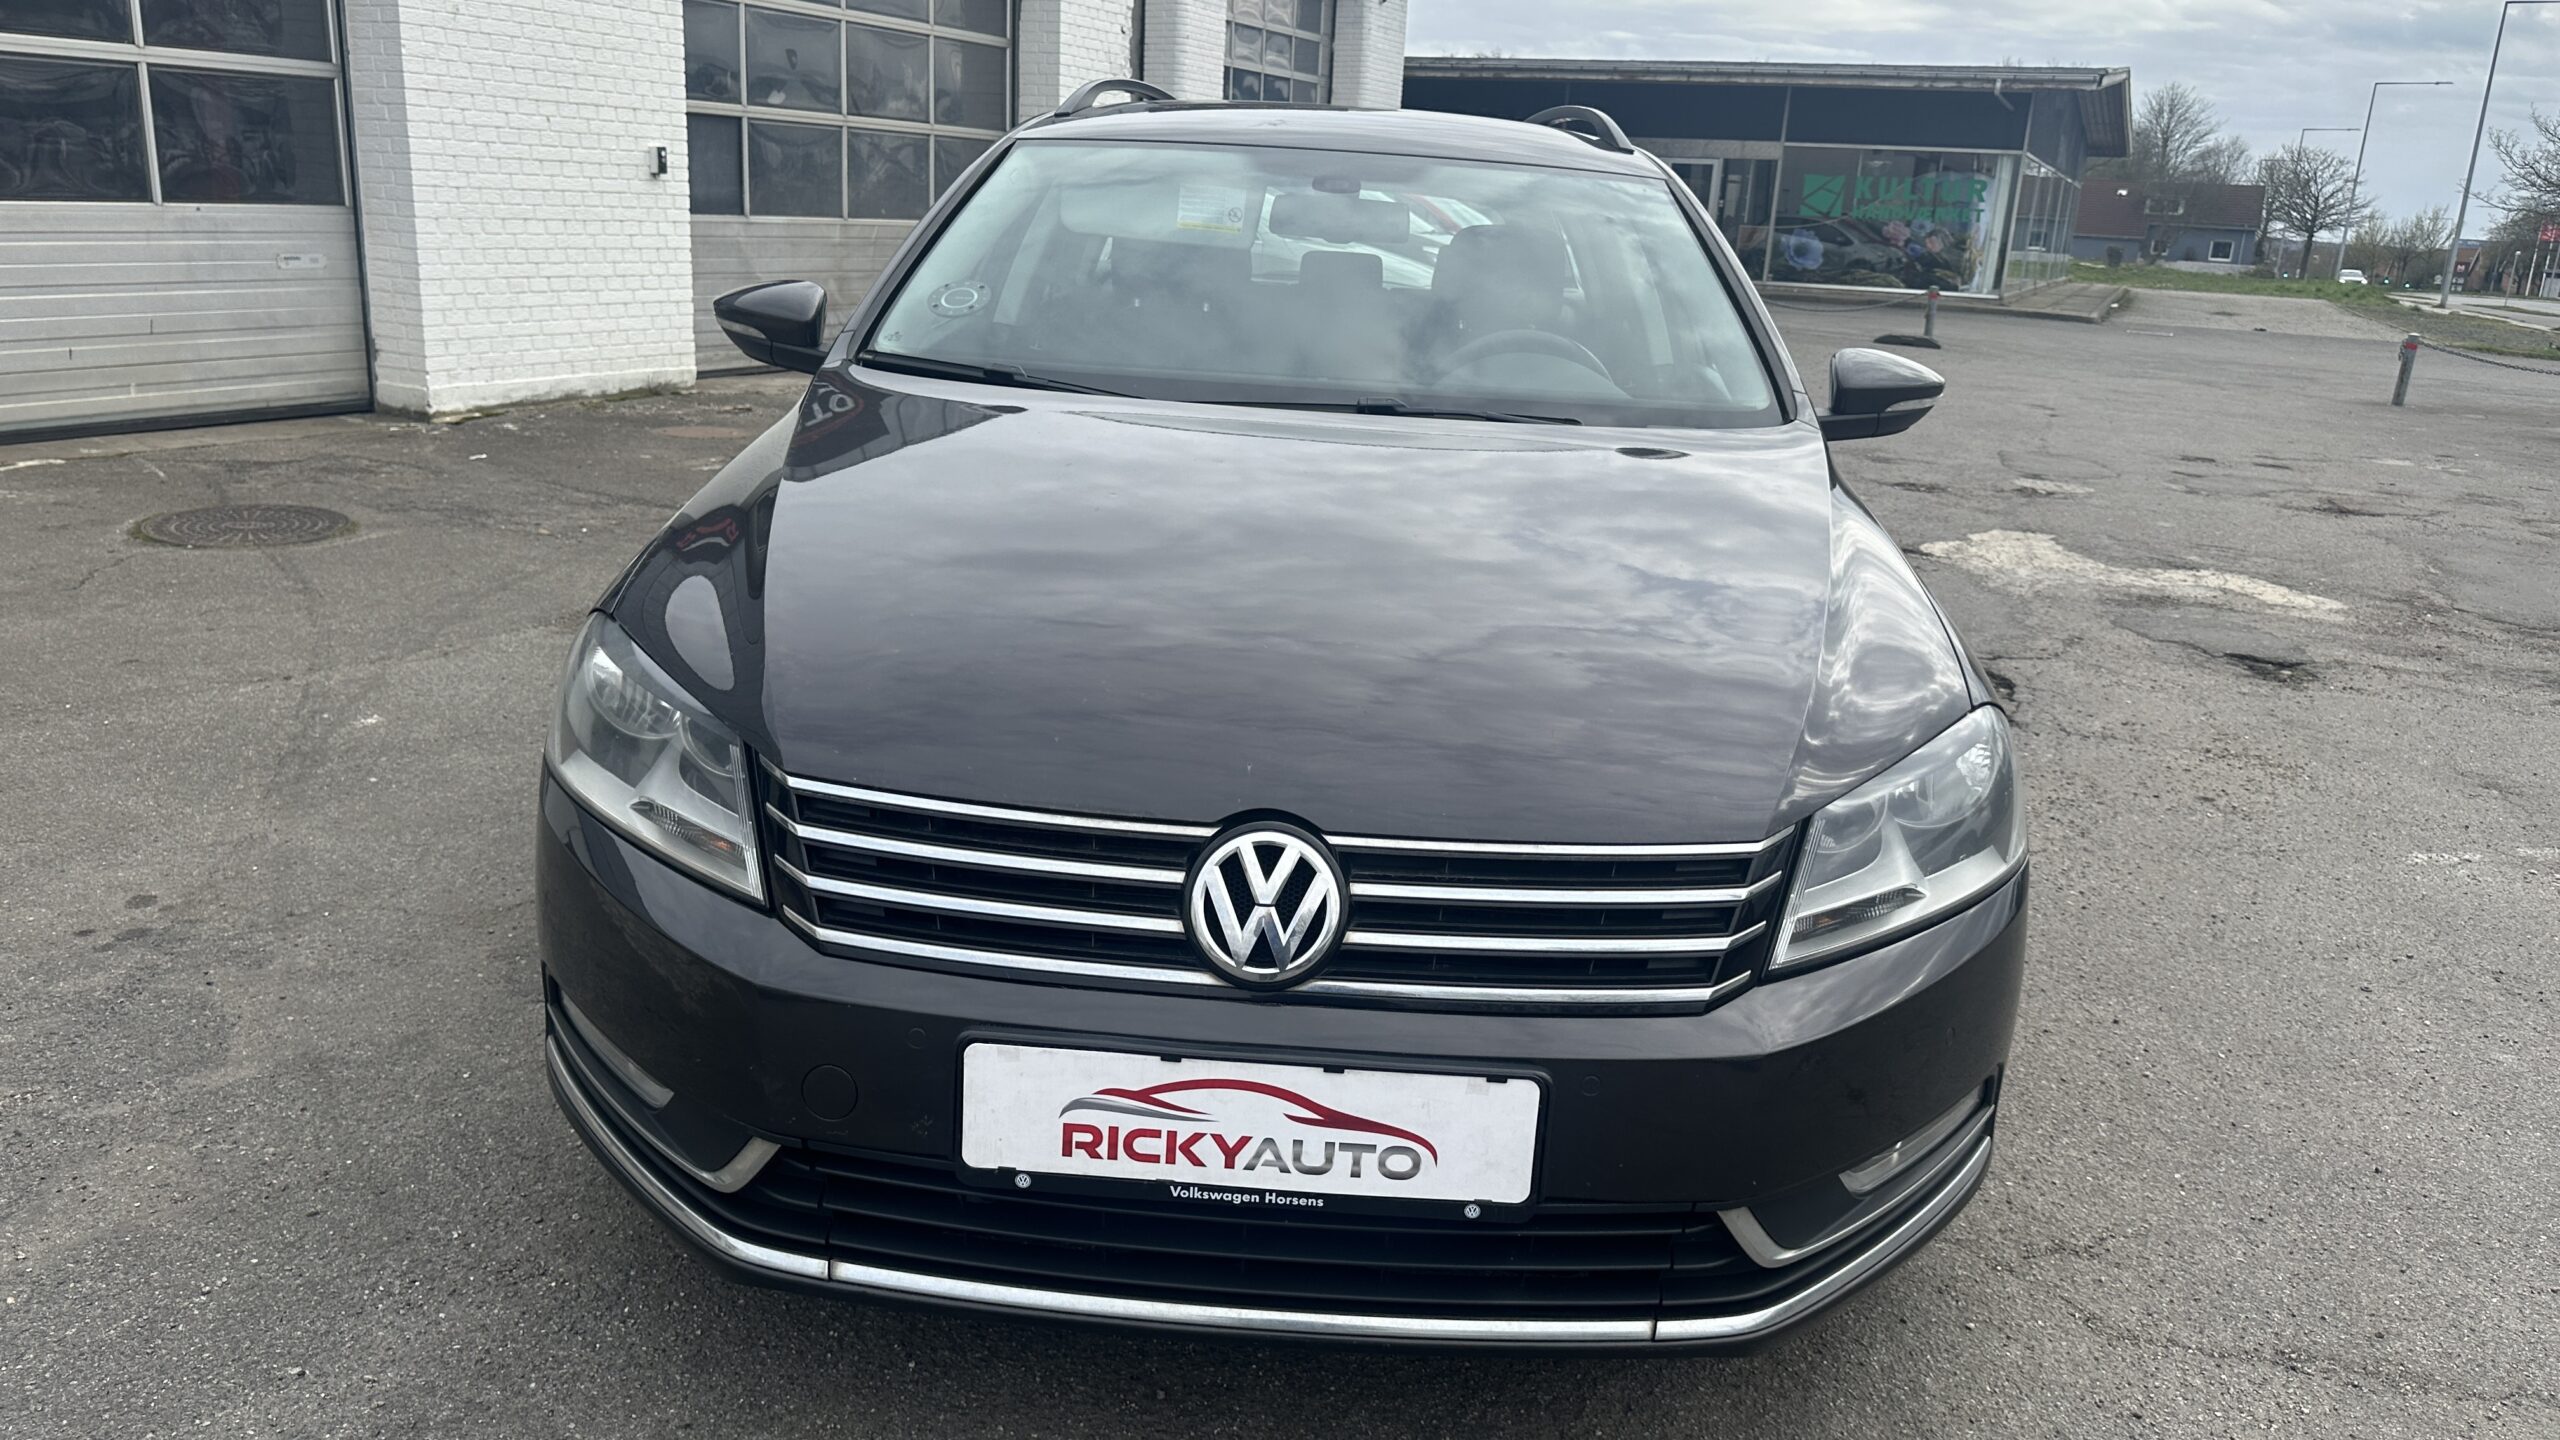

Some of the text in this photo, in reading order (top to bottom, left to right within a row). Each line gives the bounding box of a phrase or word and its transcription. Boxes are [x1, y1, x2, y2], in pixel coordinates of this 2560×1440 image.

[1855, 175, 1988, 203] KULTUR
[1062, 1122, 1422, 1181] RICKYAUTO
[1169, 1185, 1325, 1207] Volkswagen Horsens
